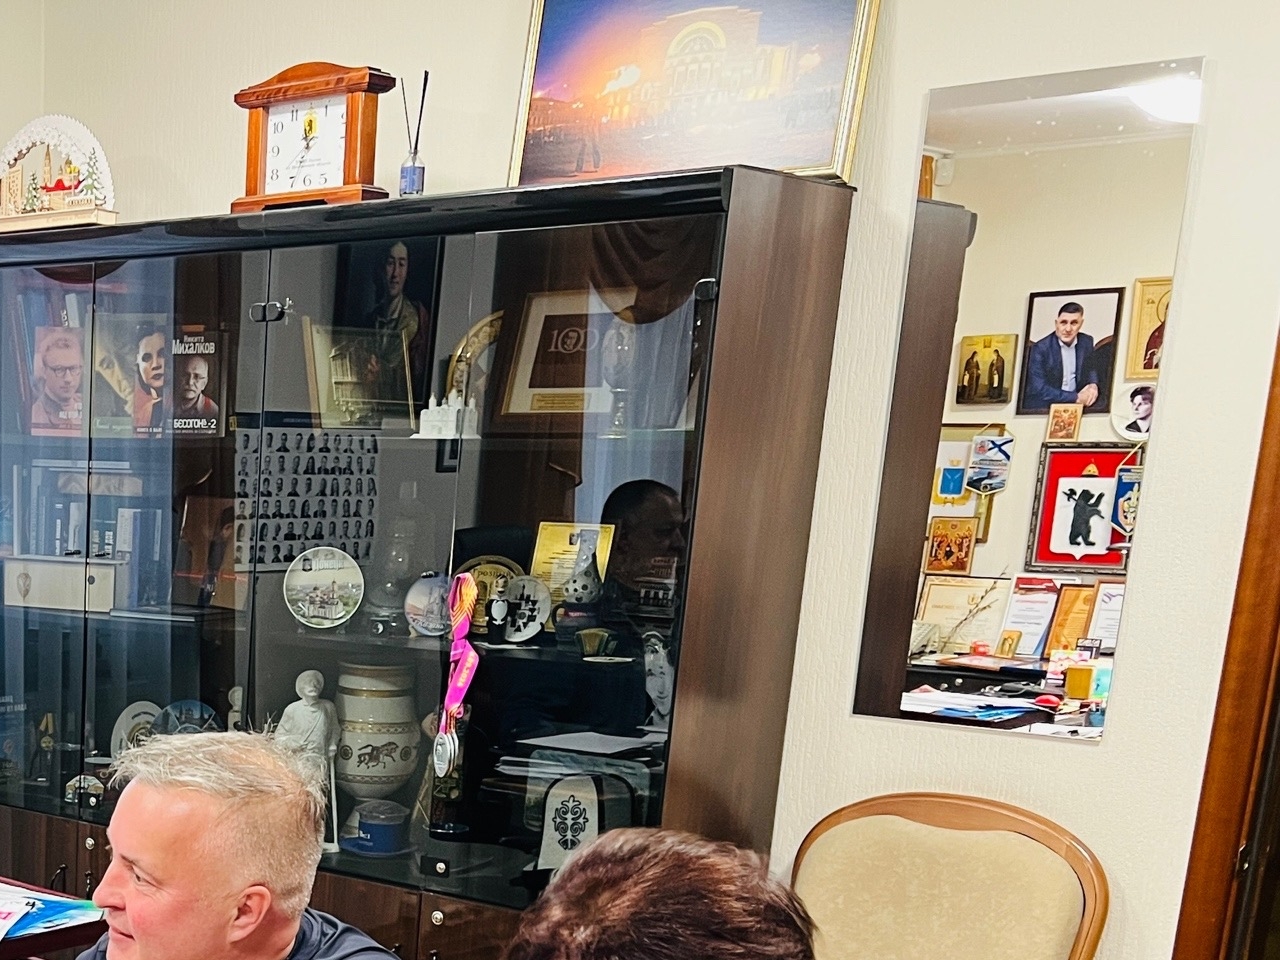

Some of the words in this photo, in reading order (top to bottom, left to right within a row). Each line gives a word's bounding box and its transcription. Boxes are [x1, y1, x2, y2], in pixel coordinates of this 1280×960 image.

[273, 121, 284, 134] 10
[271, 145, 280, 157] 9
[270, 168, 279, 181] 8
[303, 174, 312, 187] 6
[319, 173, 328, 185] 5
[289, 175, 296, 188] 7
[171, 339, 216, 355] Михалков
